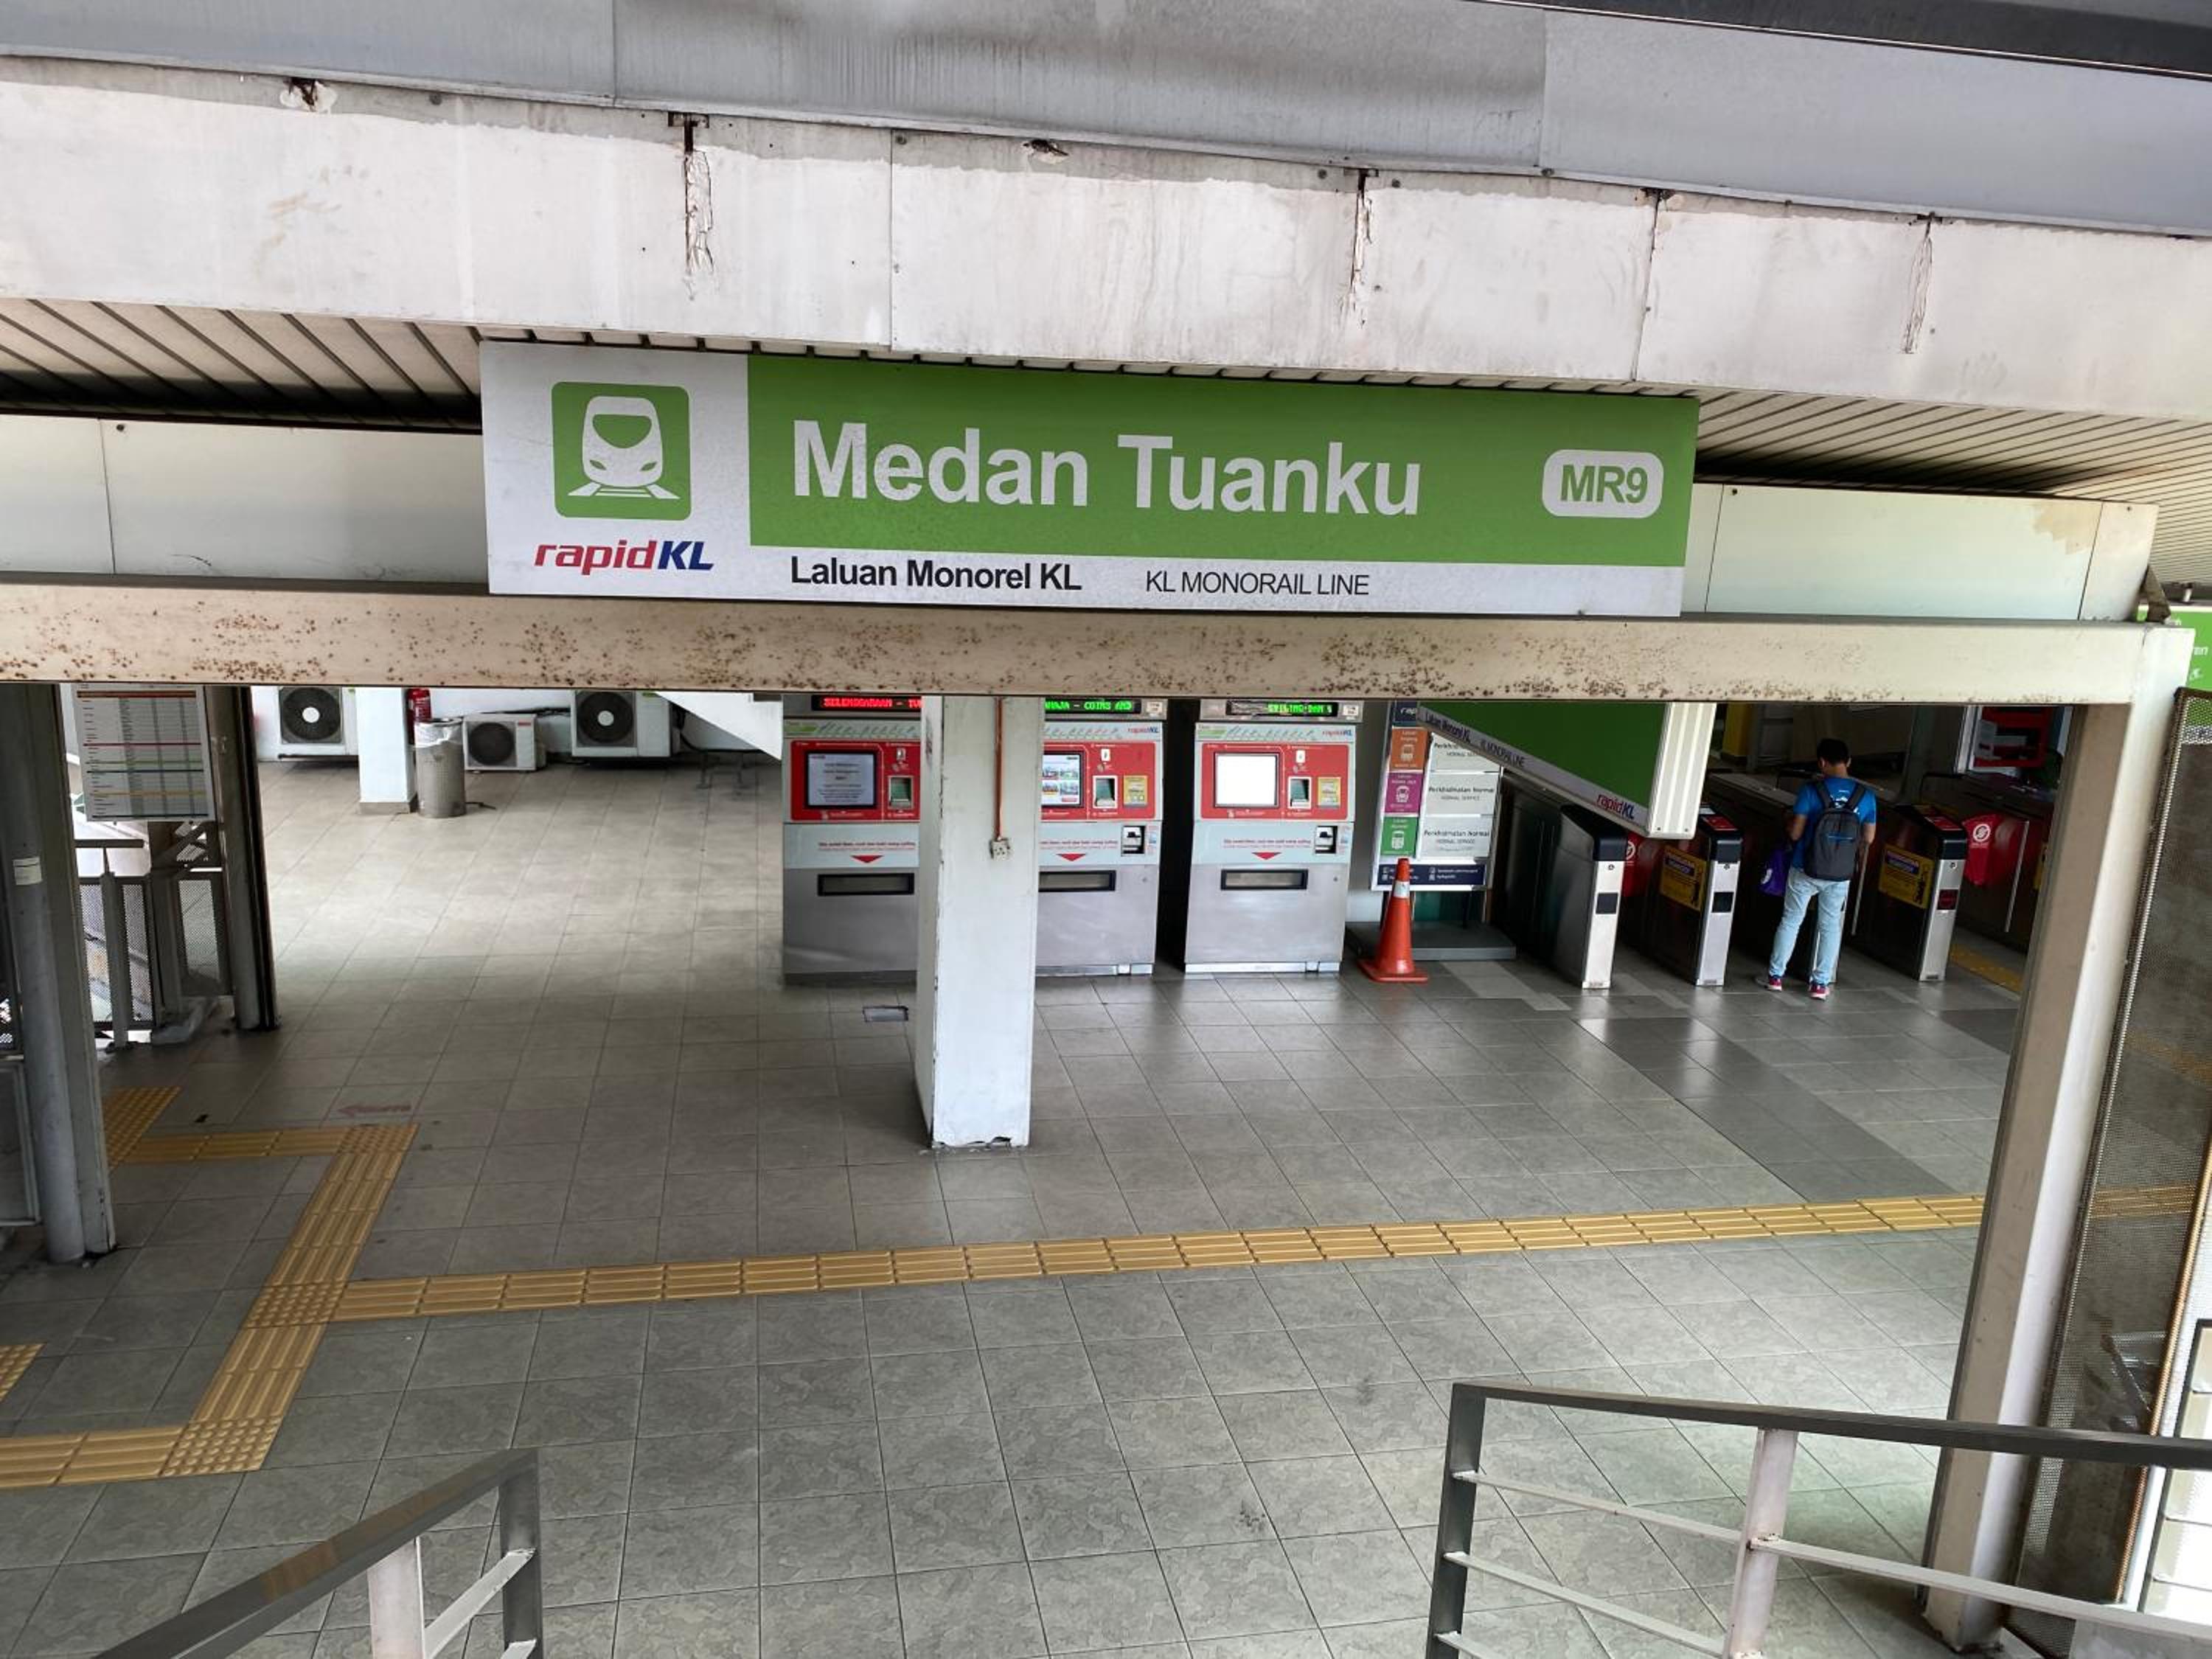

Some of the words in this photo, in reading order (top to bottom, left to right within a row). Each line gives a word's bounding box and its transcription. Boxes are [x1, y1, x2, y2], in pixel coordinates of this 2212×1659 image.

[793, 420, 1088, 507] Medan
[1117, 434, 1421, 516] Tuanku
[1559, 465, 1649, 504] MR9
[535, 540, 714, 575] rapidKL
[791, 556, 897, 587] Laluan
[907, 558, 1032, 591] Monorel
[1040, 563, 1082, 591] KL
[1146, 571, 1176, 593] KL
[1181, 571, 1312, 594] MONORAIL
[1318, 574, 1370, 596] LINE
